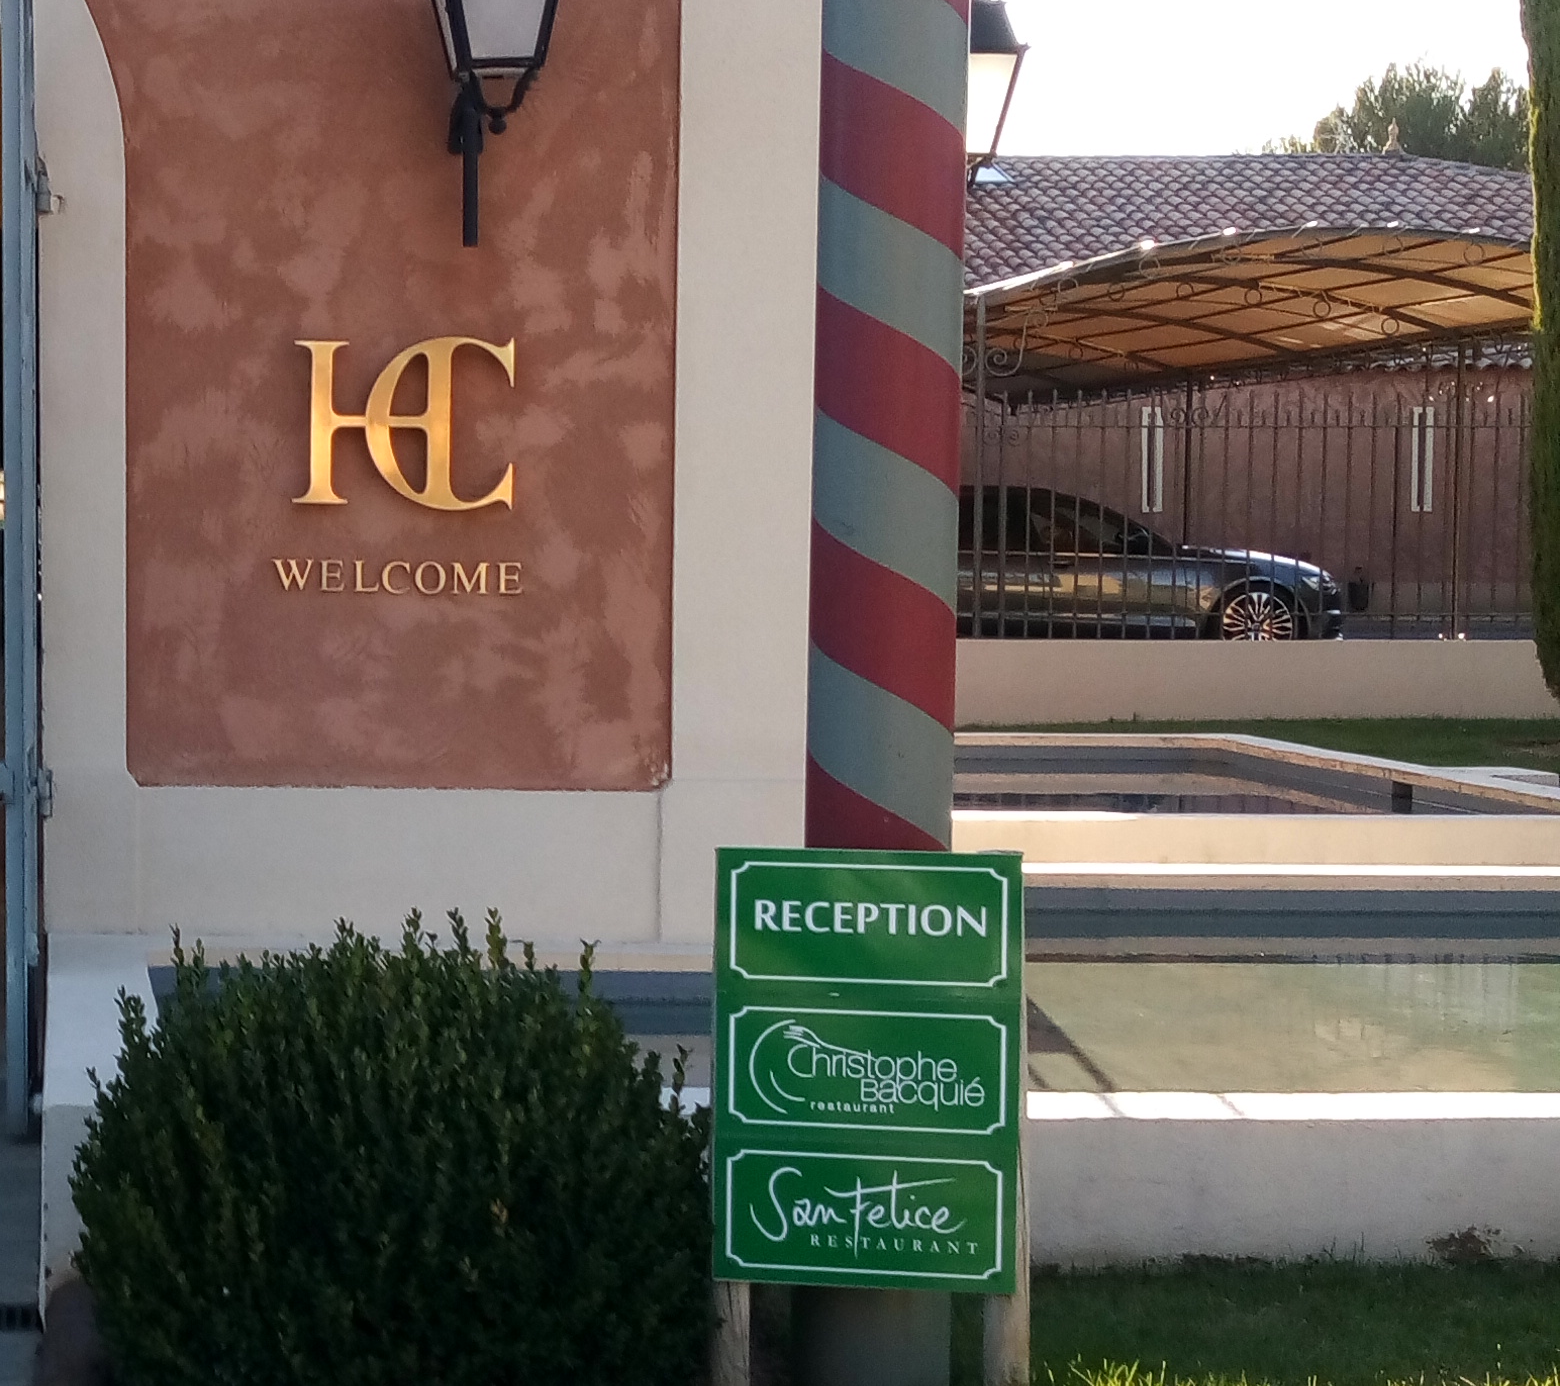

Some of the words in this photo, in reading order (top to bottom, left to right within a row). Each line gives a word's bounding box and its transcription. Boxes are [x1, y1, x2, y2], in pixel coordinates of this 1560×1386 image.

[271, 558, 524, 595] WELCOME
[754, 899, 987, 938] RECEPTION
[787, 1044, 958, 1083] Christophe
[810, 1100, 895, 1114] restaurant
[810, 1232, 980, 1256] RESTAURANT
